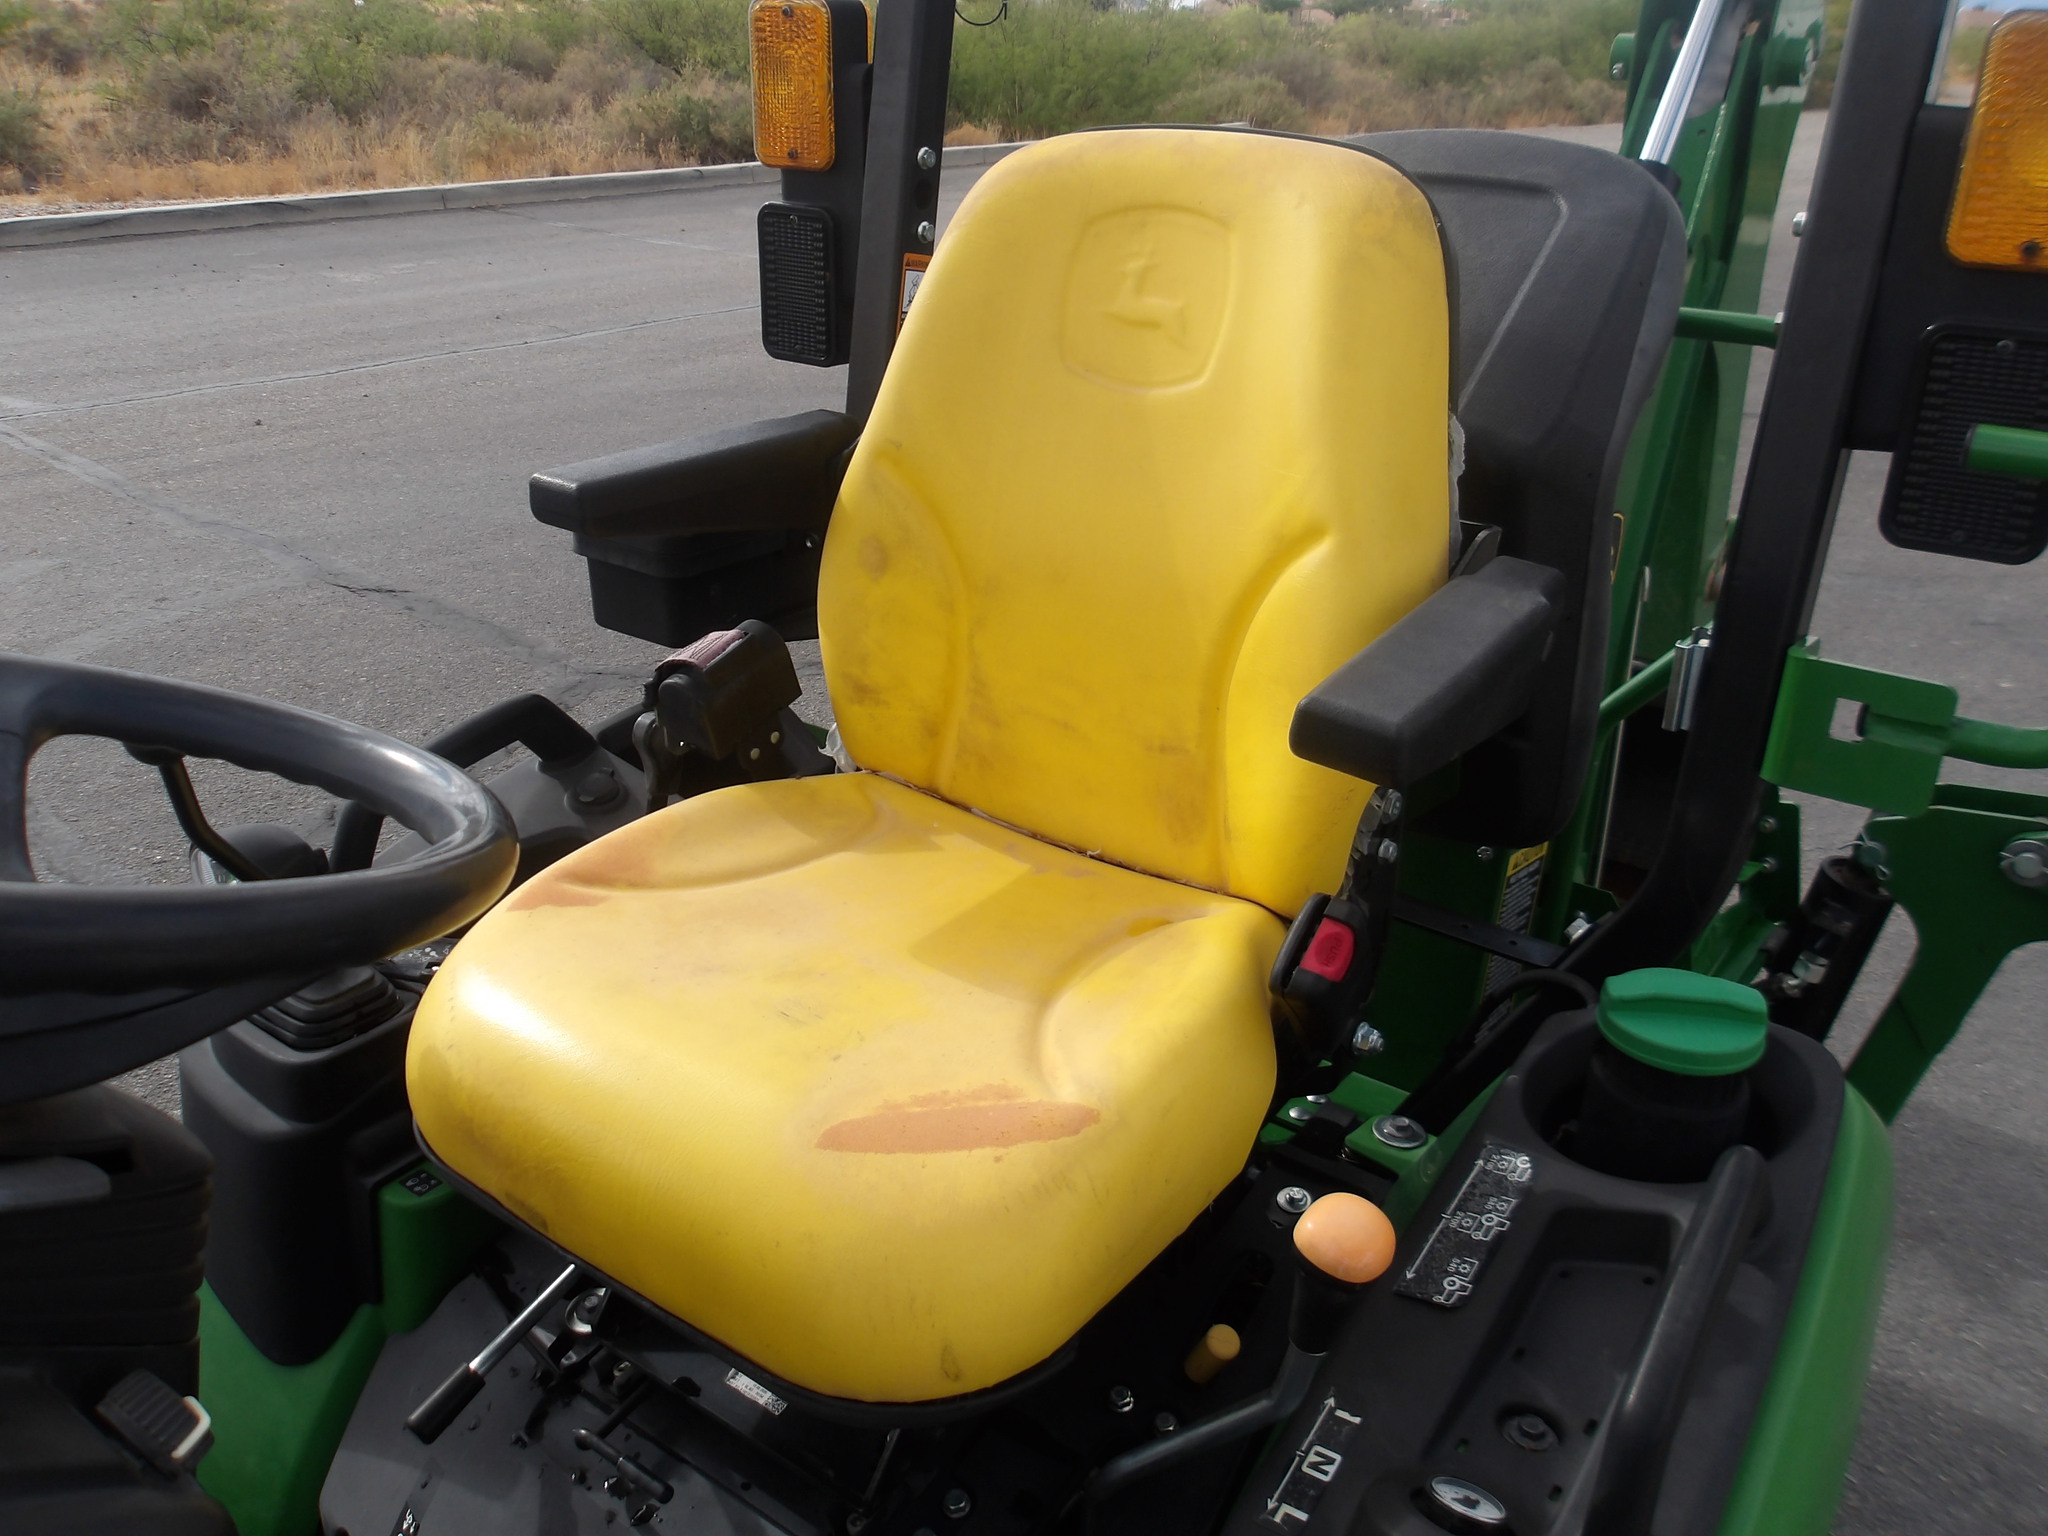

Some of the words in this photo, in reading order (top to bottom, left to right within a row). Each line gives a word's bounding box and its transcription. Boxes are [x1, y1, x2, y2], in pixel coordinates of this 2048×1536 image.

[1321, 937, 1343, 967] PUSH
[1449, 1210, 1465, 1228] 2100
[1306, 1449, 1337, 1477] N
[1273, 1502, 1309, 1524] L
